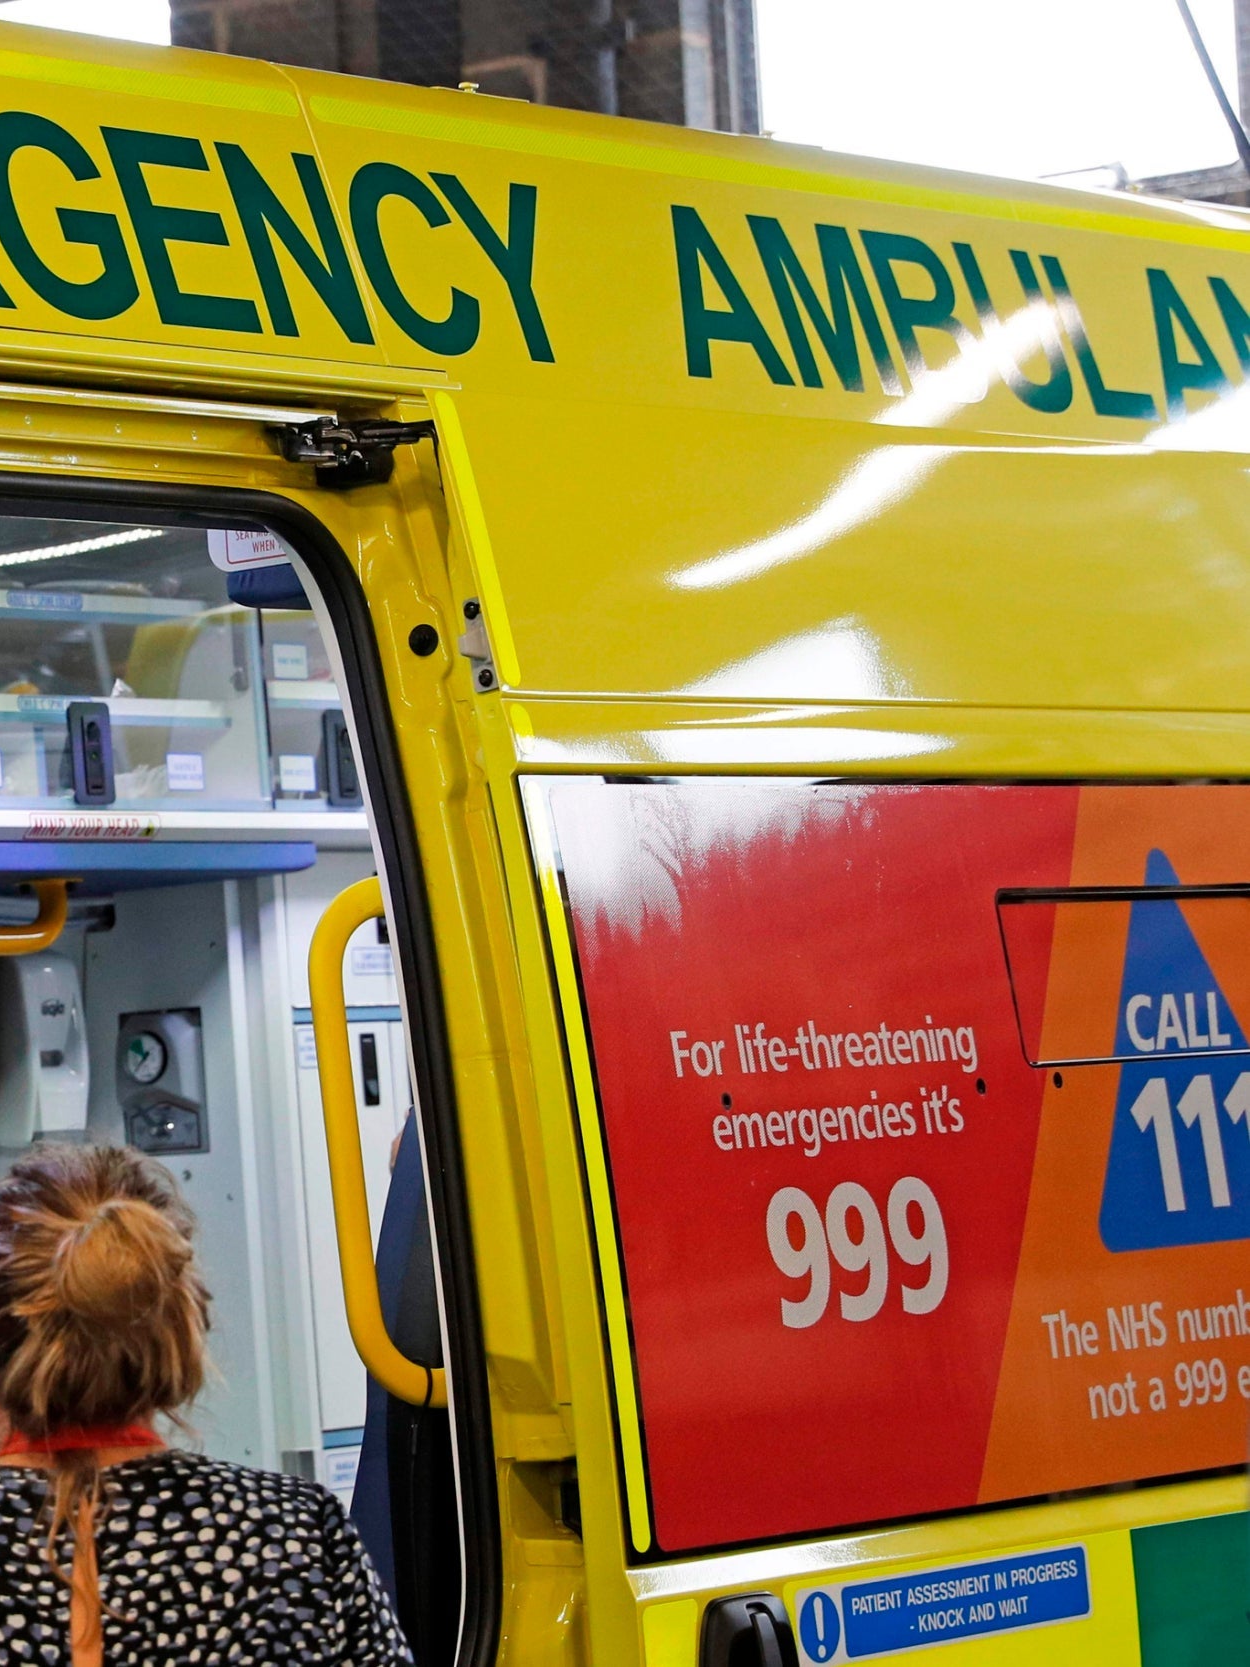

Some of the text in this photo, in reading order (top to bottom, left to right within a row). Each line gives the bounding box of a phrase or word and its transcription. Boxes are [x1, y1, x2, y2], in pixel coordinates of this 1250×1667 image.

[252, 540, 275, 553] WHEN
[30, 818, 140, 836] MIND YOUR HEAD
[669, 1015, 978, 1078] For life-threatening
[1126, 992, 1231, 1052] CALL
[713, 1085, 965, 1157] emergencies it's
[766, 1176, 949, 1329] 999
[1041, 1309, 1099, 1359] The
[1106, 1301, 1168, 1352] NHS
[1088, 1372, 1140, 1420] not
[1148, 1377, 1166, 1412] a
[1174, 1357, 1228, 1408] 999
[851, 1559, 1078, 1616] PATIENT ASSESSMENT IN PROGRESS
[918, 1608, 965, 1633] KNOCK
[968, 1602, 996, 1624] AND
[998, 1596, 1029, 1618] WAIT
